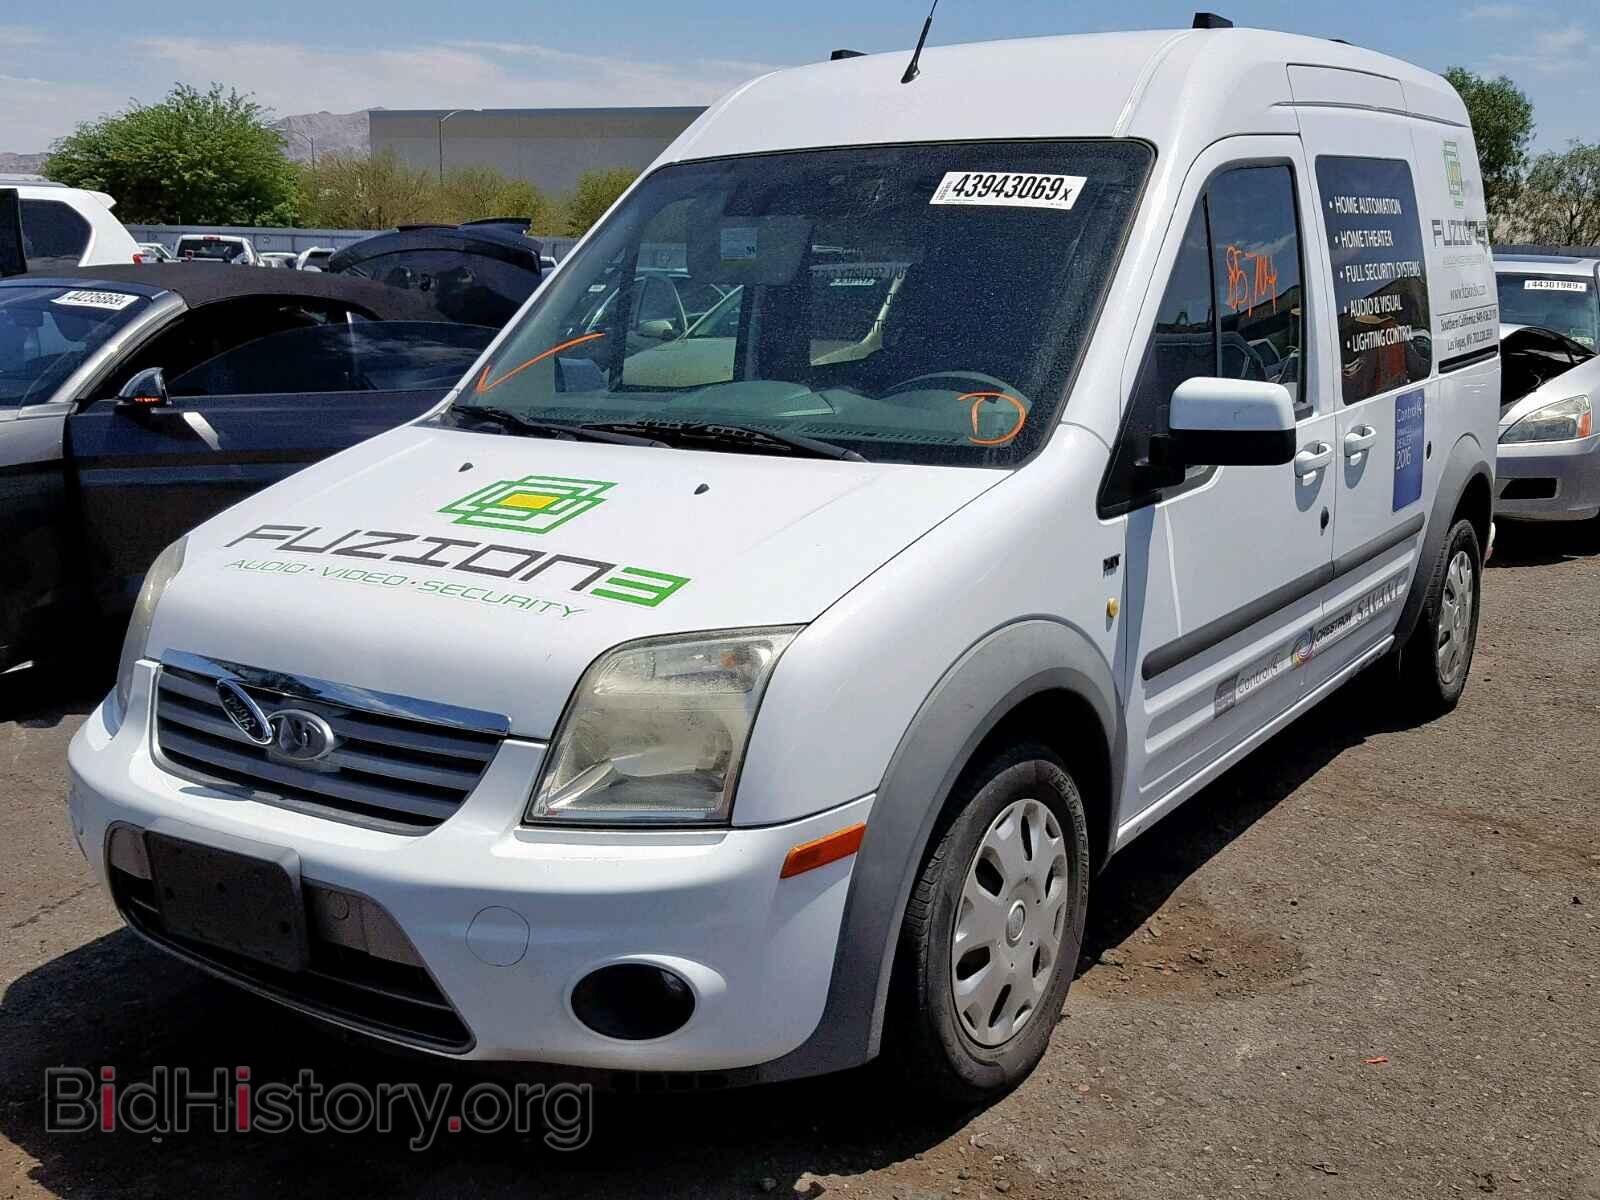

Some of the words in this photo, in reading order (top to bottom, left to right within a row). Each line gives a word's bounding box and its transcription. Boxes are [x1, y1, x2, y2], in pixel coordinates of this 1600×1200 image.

[1334, 196, 1358, 214] HOME
[1358, 197, 1402, 215] AUTOMATION
[1340, 229, 1364, 248] HOME
[1364, 229, 1394, 248] THEATER
[1345, 265, 1365, 282] FULL
[1365, 262, 1396, 280] SECURITY
[1396, 261, 1421, 278] SYSTEMS
[1350, 298, 1374, 317] AUDIO
[1374, 297, 1380, 313] &
[1380, 294, 1403, 313] VISUAL
[1353, 329, 1385, 352] LIGHTING
[1385, 325, 1414, 346] CONTROL
[957, 391, 1026, 446] D
[225, 560, 308, 574] AUDIO
[322, 566, 409, 586] VIDEO
[416, 580, 584, 618] SECURITY
